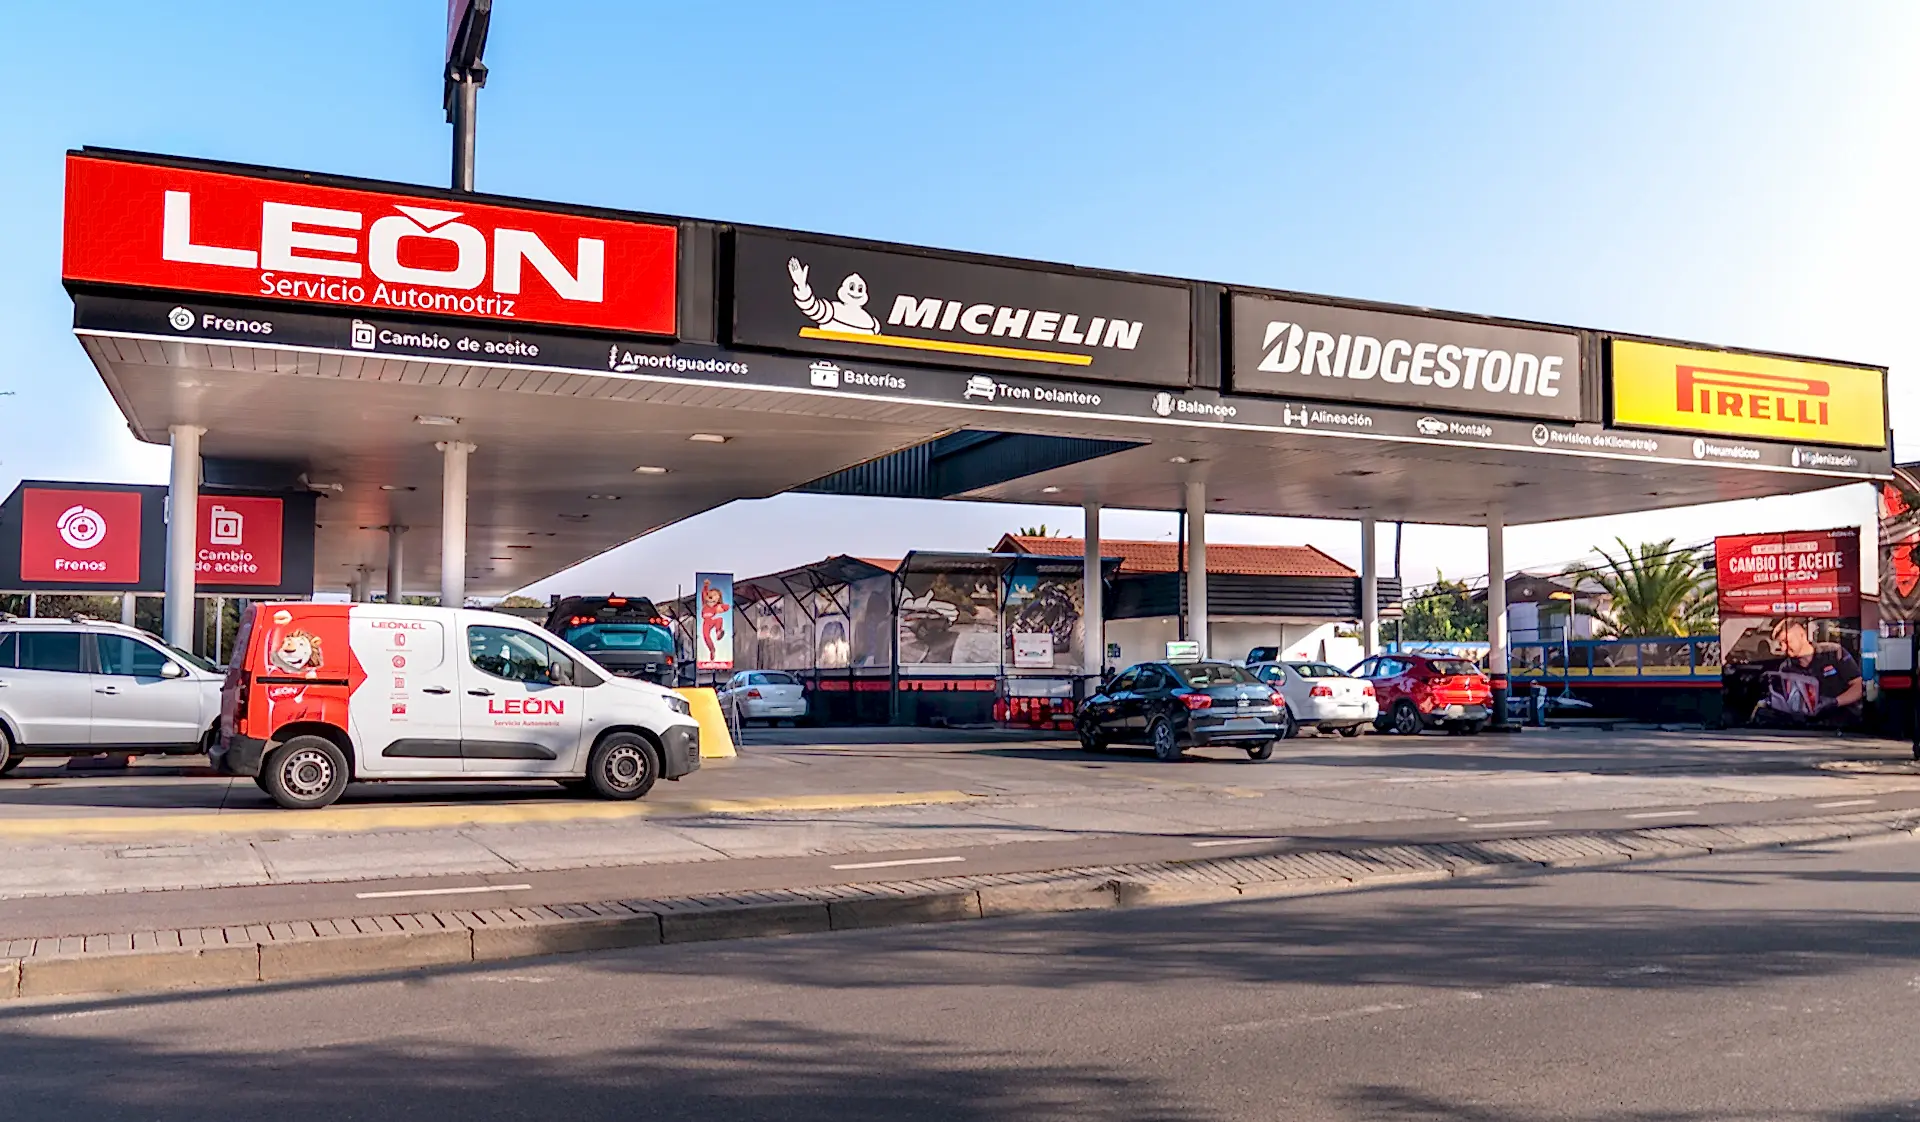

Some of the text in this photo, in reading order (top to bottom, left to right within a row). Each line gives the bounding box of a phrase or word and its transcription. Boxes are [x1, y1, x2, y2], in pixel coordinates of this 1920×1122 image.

[260, 272, 515, 317] Servicio Automotriz
[202, 314, 273, 334] Frenos
[887, 294, 1144, 350] MICHELIN
[378, 330, 540, 357] Cambio de aceite
[621, 351, 749, 375] Amortiguadores
[1257, 320, 1564, 397] BRIDGESTONE
[843, 369, 907, 390] Baterías
[998, 383, 1101, 406] Tren Delantero
[1676, 364, 1830, 426] PIRELLI
[1177, 399, 1237, 418] Balanceo
[1310, 410, 1373, 427] Alineación
[1449, 422, 1493, 438] Montaje
[55, 558, 107, 572] Frenos
[198, 549, 253, 562] Cambio
[1729, 551, 1844, 573] CAMBIO DE ACEITE
[214, 562, 258, 574] aceite
